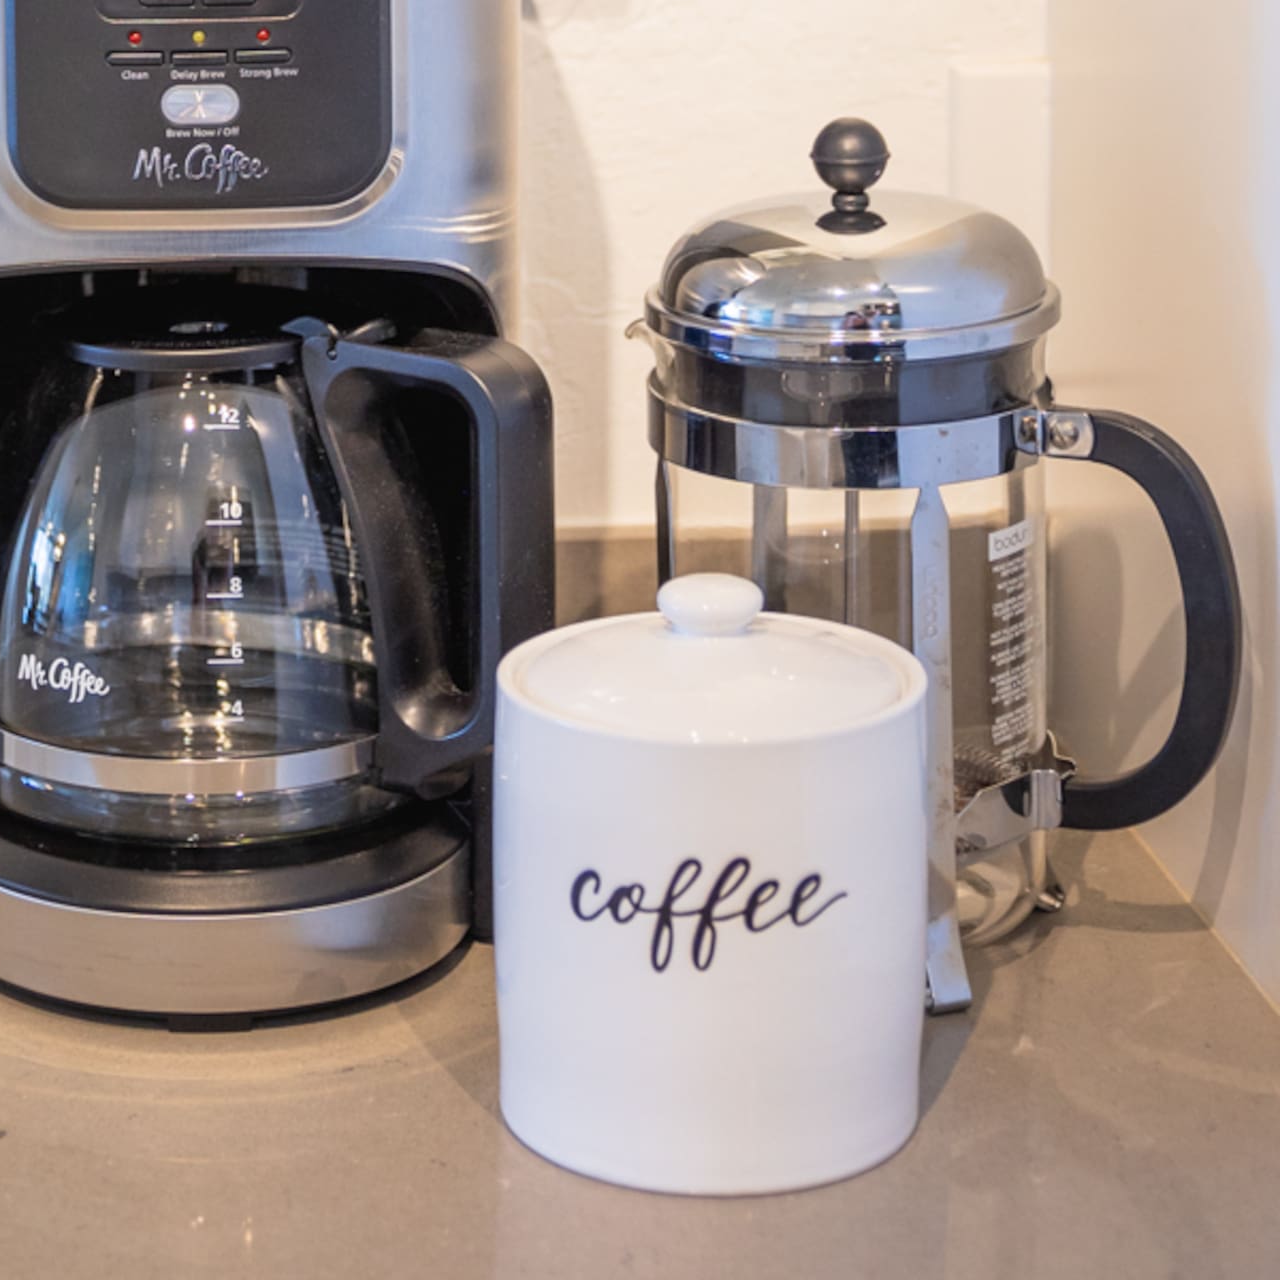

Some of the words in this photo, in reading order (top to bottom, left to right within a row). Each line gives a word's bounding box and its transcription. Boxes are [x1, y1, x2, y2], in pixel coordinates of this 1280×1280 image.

[120, 69, 150, 80] Clean
[170, 69, 198, 81] Delay
[200, 69, 226, 79] Brew
[239, 67, 272, 80] Strong
[273, 67, 299, 77] Brew
[166, 128, 191, 138] Brew
[193, 127, 216, 137] Now
[223, 126, 240, 137] Off
[133, 146, 181, 188] Mr.
[185, 142, 269, 194] Coffee
[220, 501, 242, 519] 10
[230, 576, 242, 593] 8
[231, 642, 243, 658] 6
[18, 653, 48, 691] Mr.
[48, 657, 110, 703] Coffee
[231, 699, 243, 715] 4
[570, 856, 849, 974] coffee
